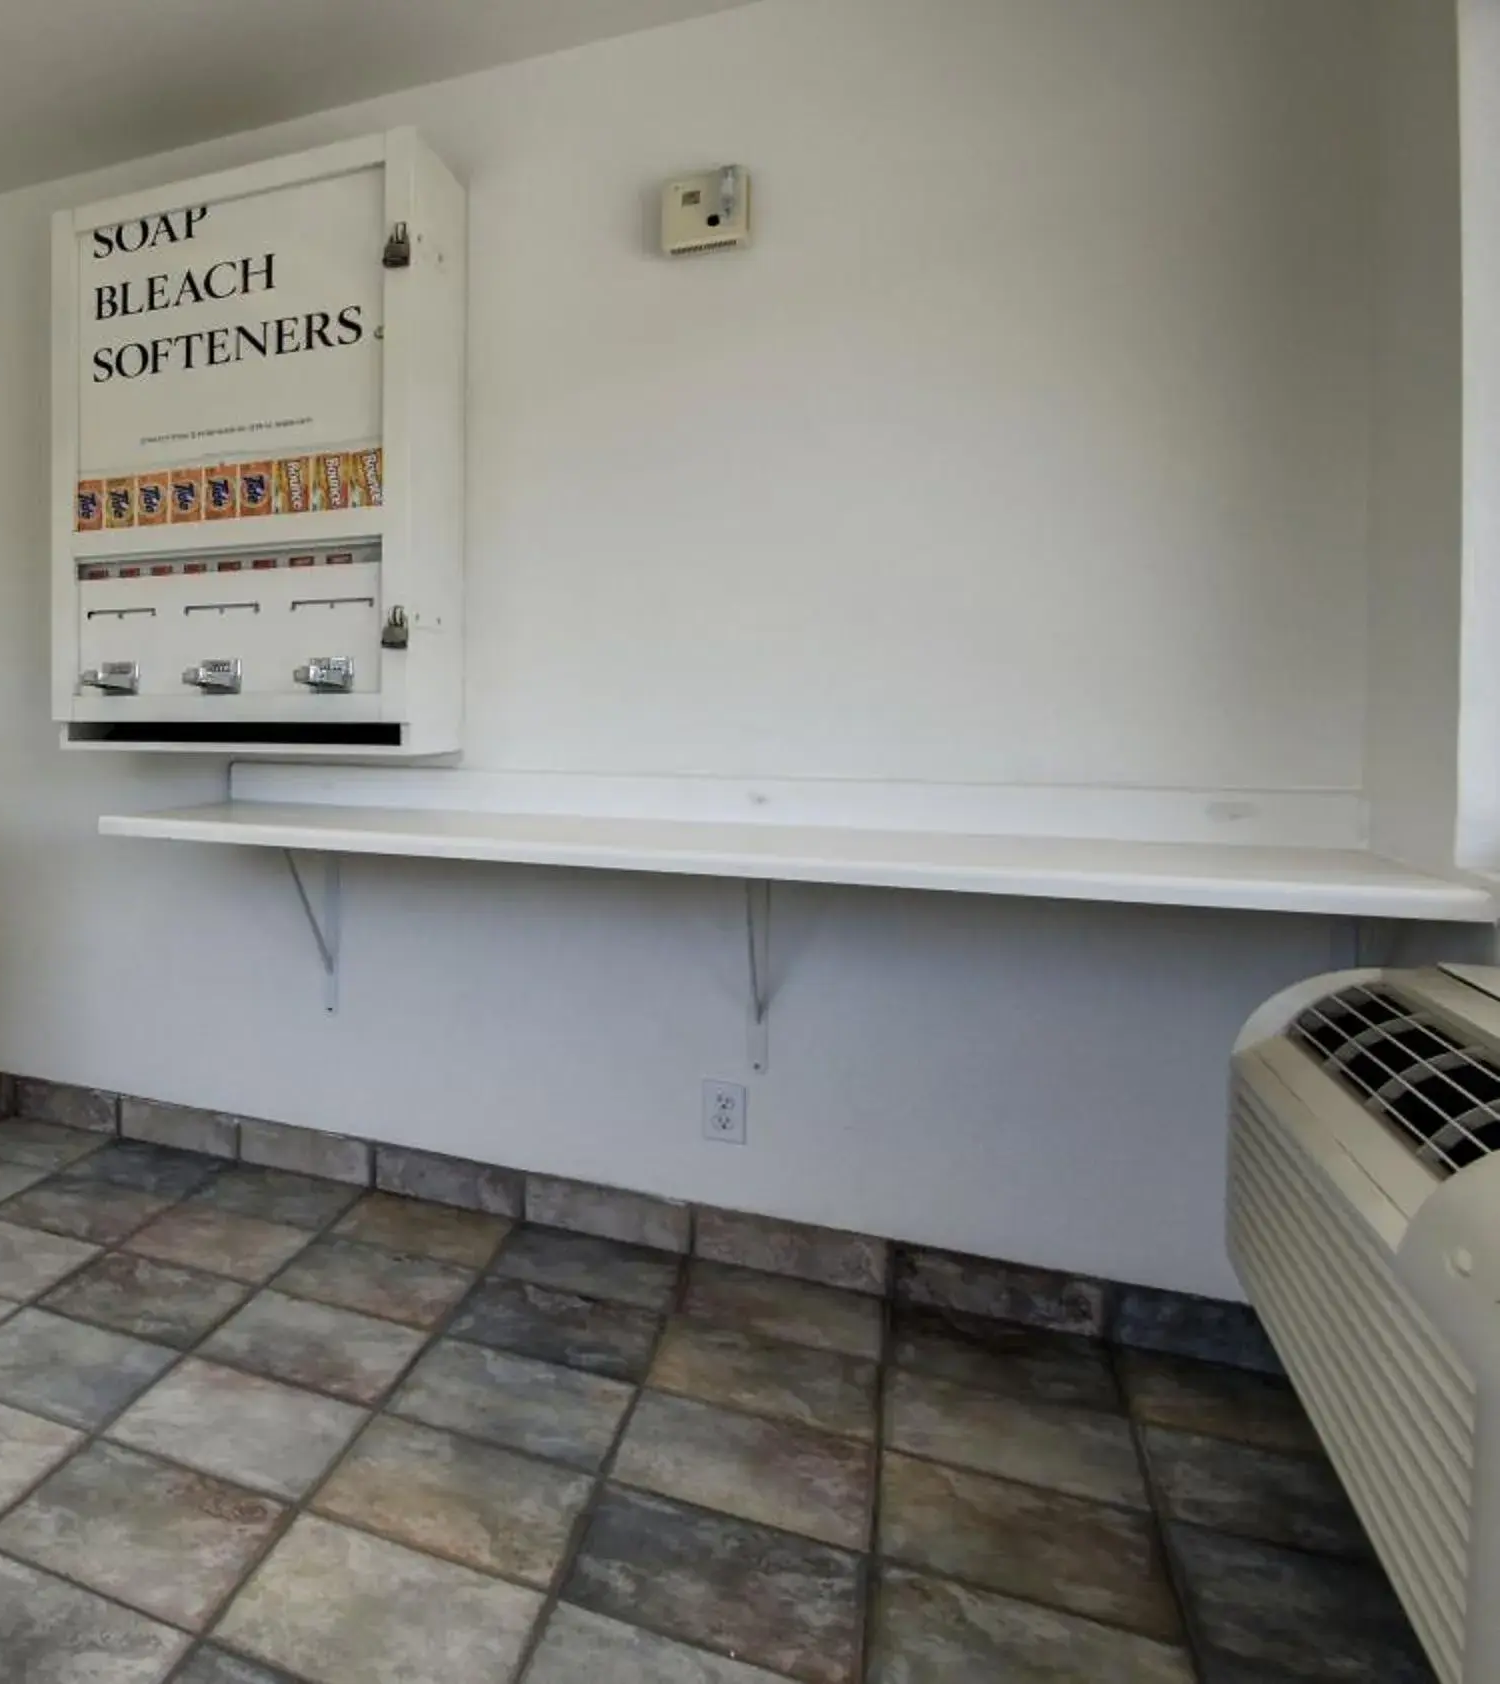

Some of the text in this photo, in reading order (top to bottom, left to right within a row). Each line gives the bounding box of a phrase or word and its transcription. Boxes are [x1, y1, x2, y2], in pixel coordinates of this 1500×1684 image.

[92, 203, 208, 259] SOAP
[94, 253, 276, 321] BLEACH
[92, 305, 364, 383] SOFTENERS
